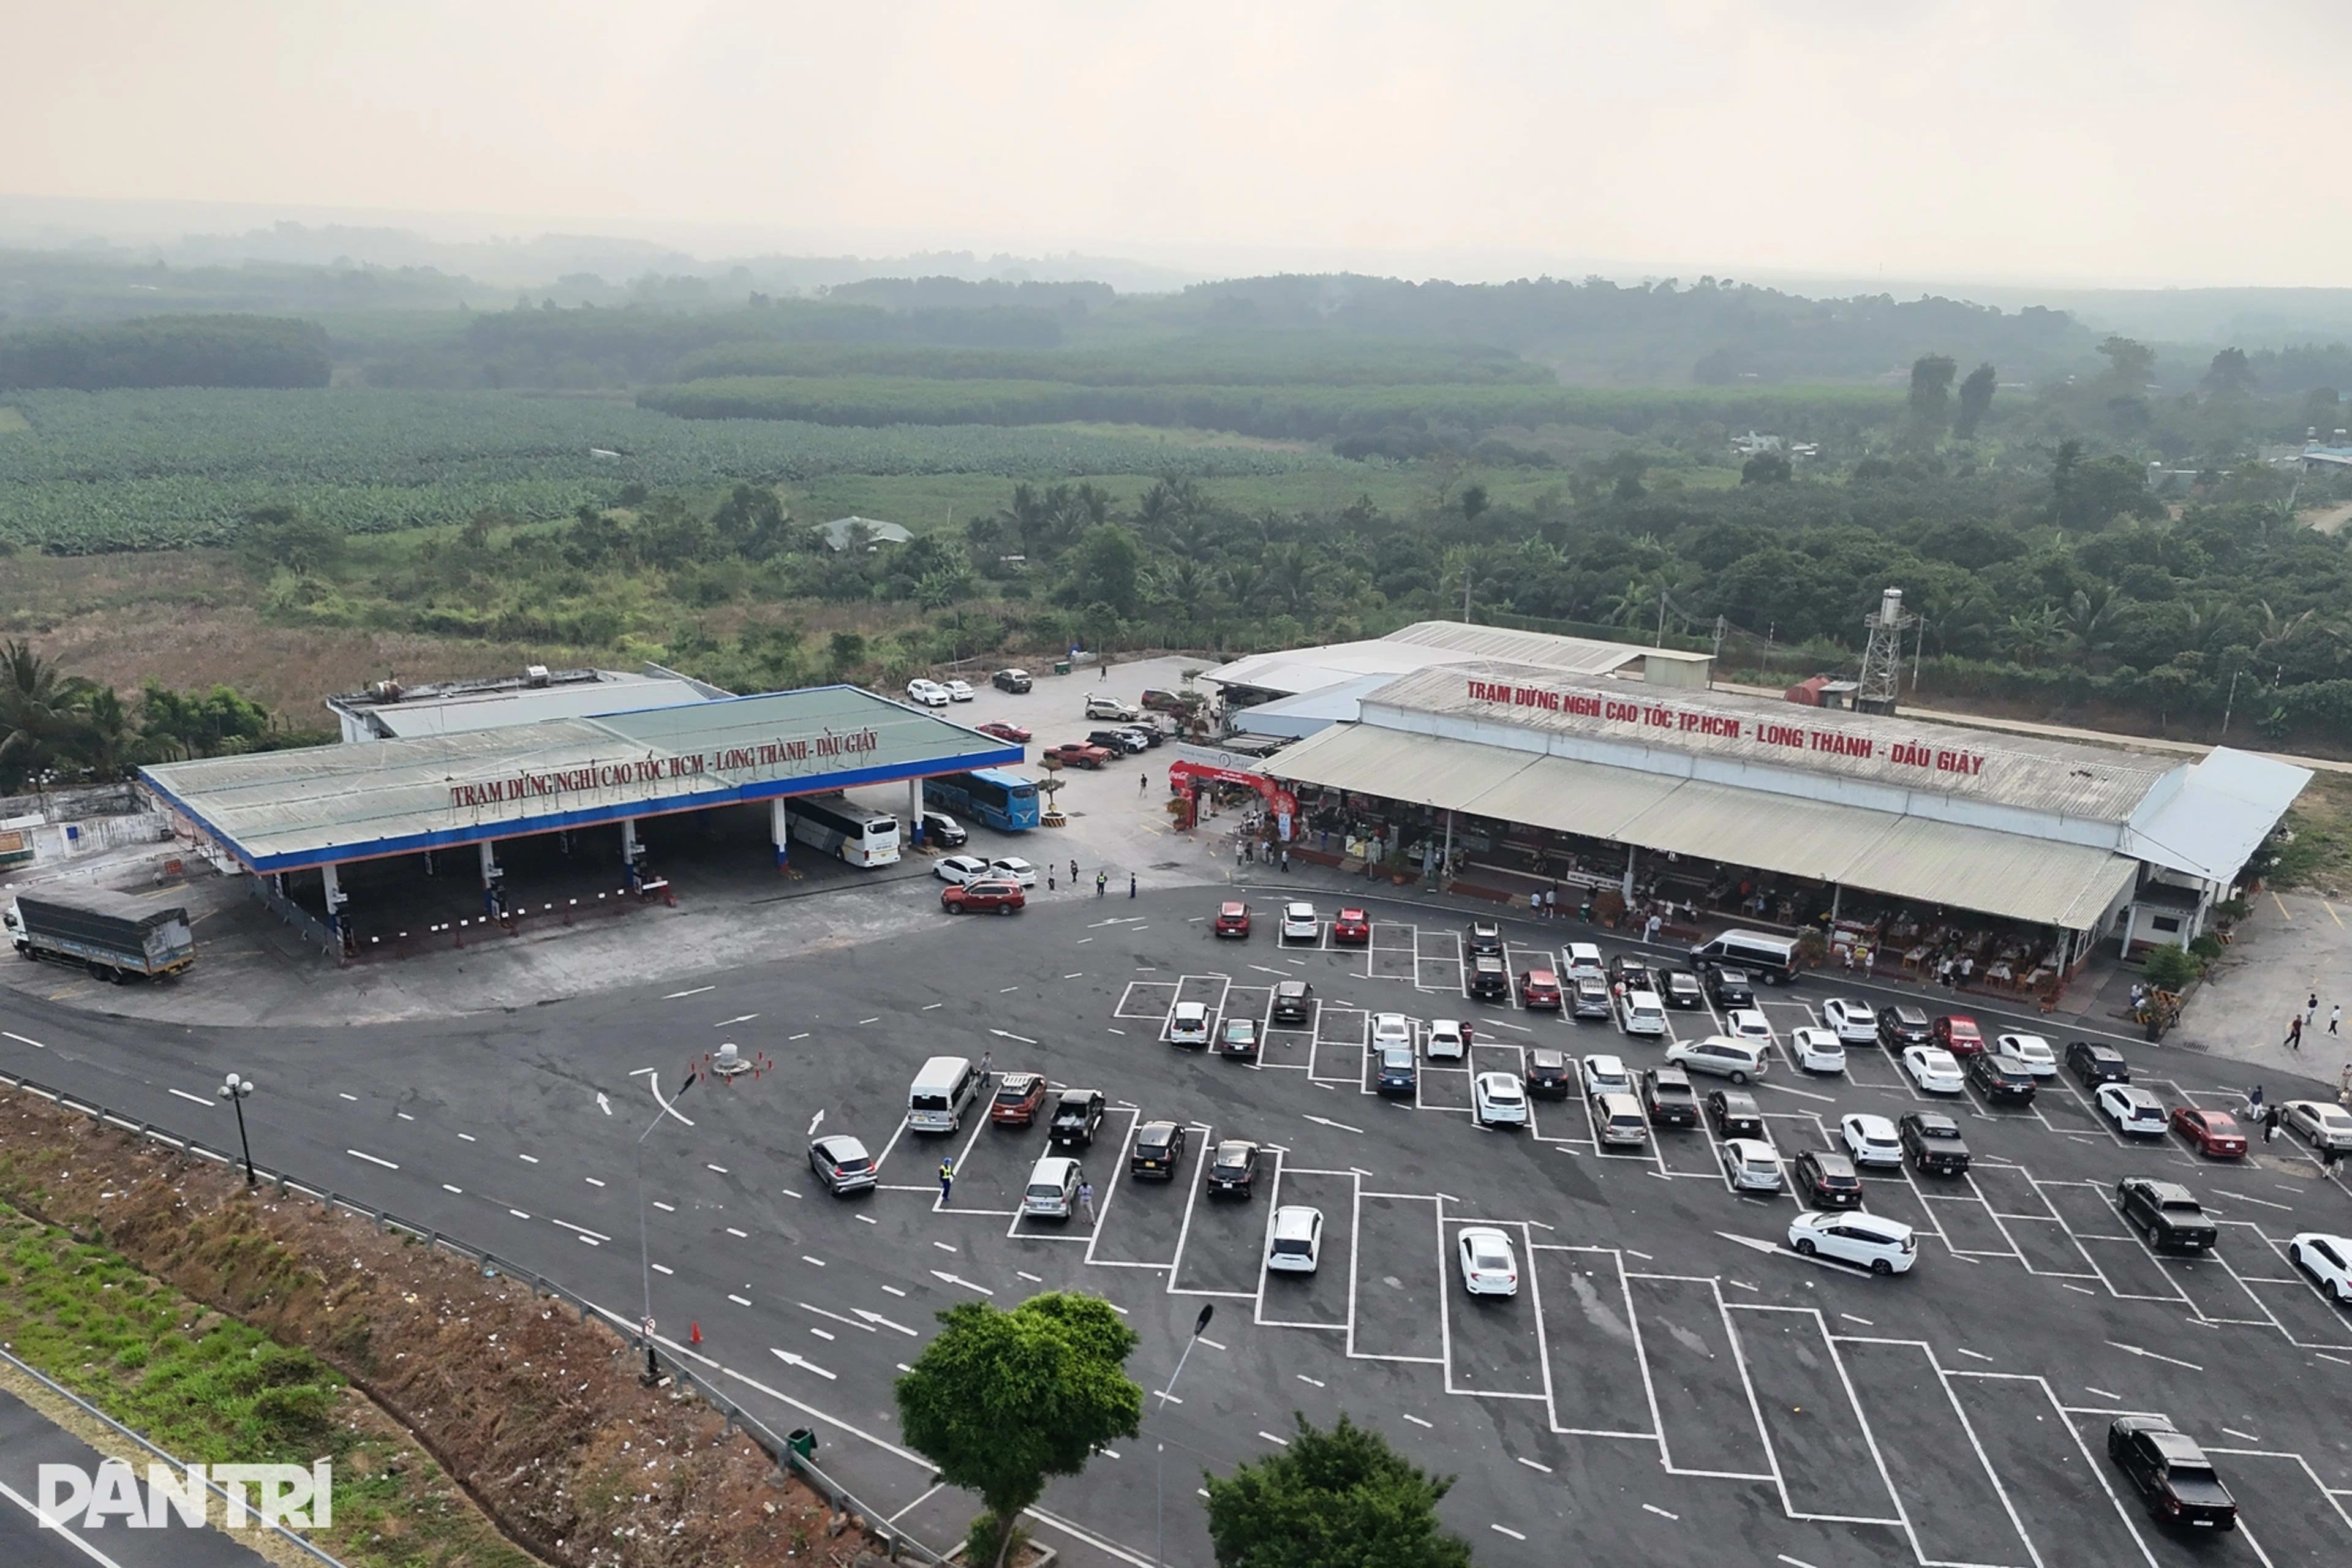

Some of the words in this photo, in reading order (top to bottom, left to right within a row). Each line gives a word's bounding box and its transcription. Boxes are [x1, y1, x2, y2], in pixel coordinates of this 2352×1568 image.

[1468, 681, 1511, 706] TRẠM
[1515, 685, 1559, 710] DỪNG
[1563, 693, 1602, 717] NGHỈ
[1606, 701, 1638, 722] CAO
[1643, 701, 1673, 728] TỐC
[1678, 712, 1740, 738] TP.HCM
[1757, 724, 1804, 748] LONG
[1811, 731, 1872, 758] THÀNH
[508, 770, 552, 801] DỪNG
[601, 763, 631, 786] CAO
[635, 750, 665, 782] TỐC
[668, 754, 704, 778] HCM
[715, 747, 755, 771] LONG
[757, 737, 807, 765] THÀNH
